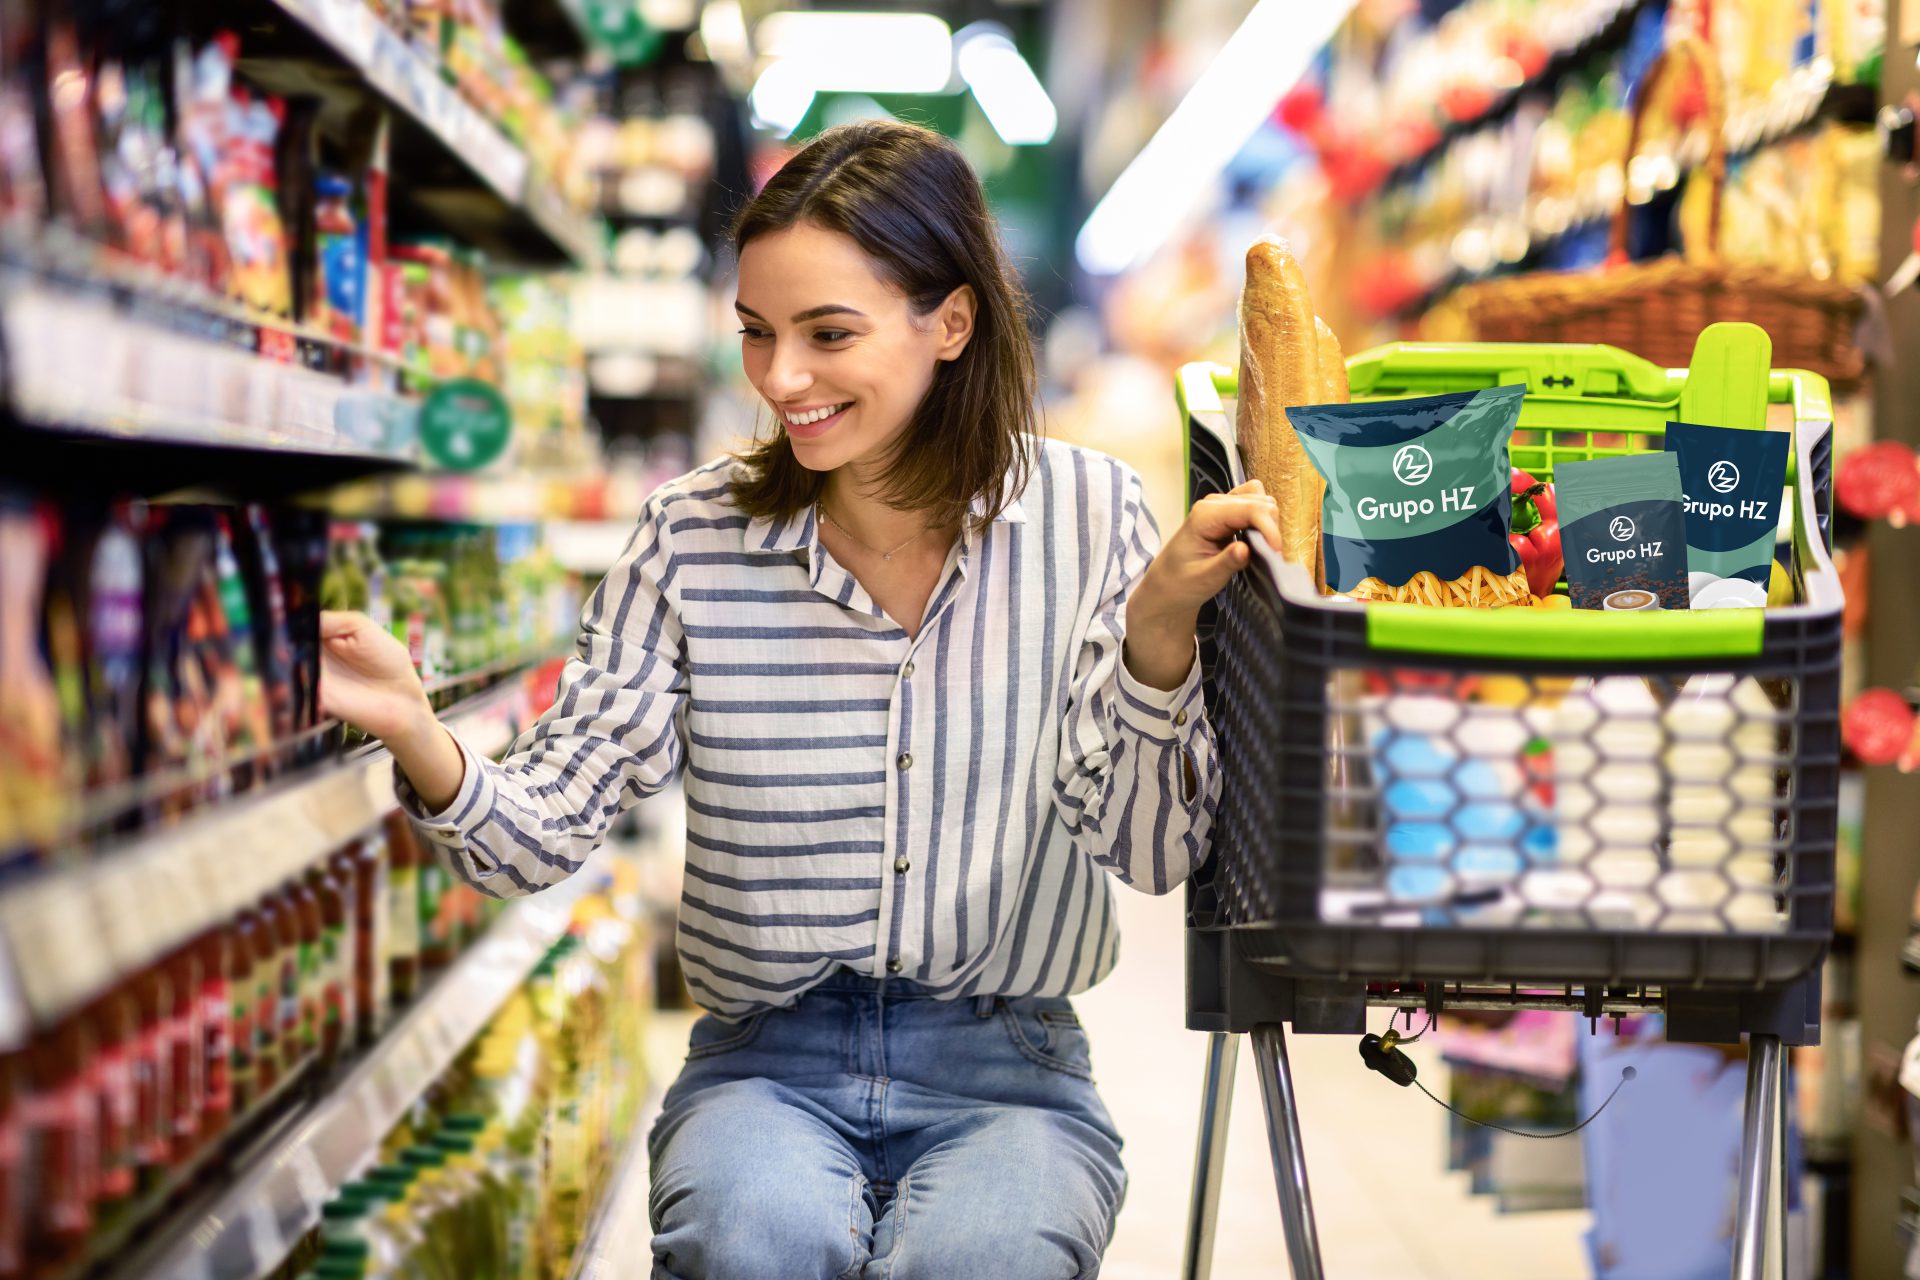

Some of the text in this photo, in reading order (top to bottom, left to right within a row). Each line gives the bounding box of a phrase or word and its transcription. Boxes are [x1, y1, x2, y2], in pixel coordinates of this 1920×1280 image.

[1357, 486, 1477, 523] Grupo HZ
[1739, 499, 1769, 520] HZ
[1586, 541, 1664, 565] Grupo HZ
